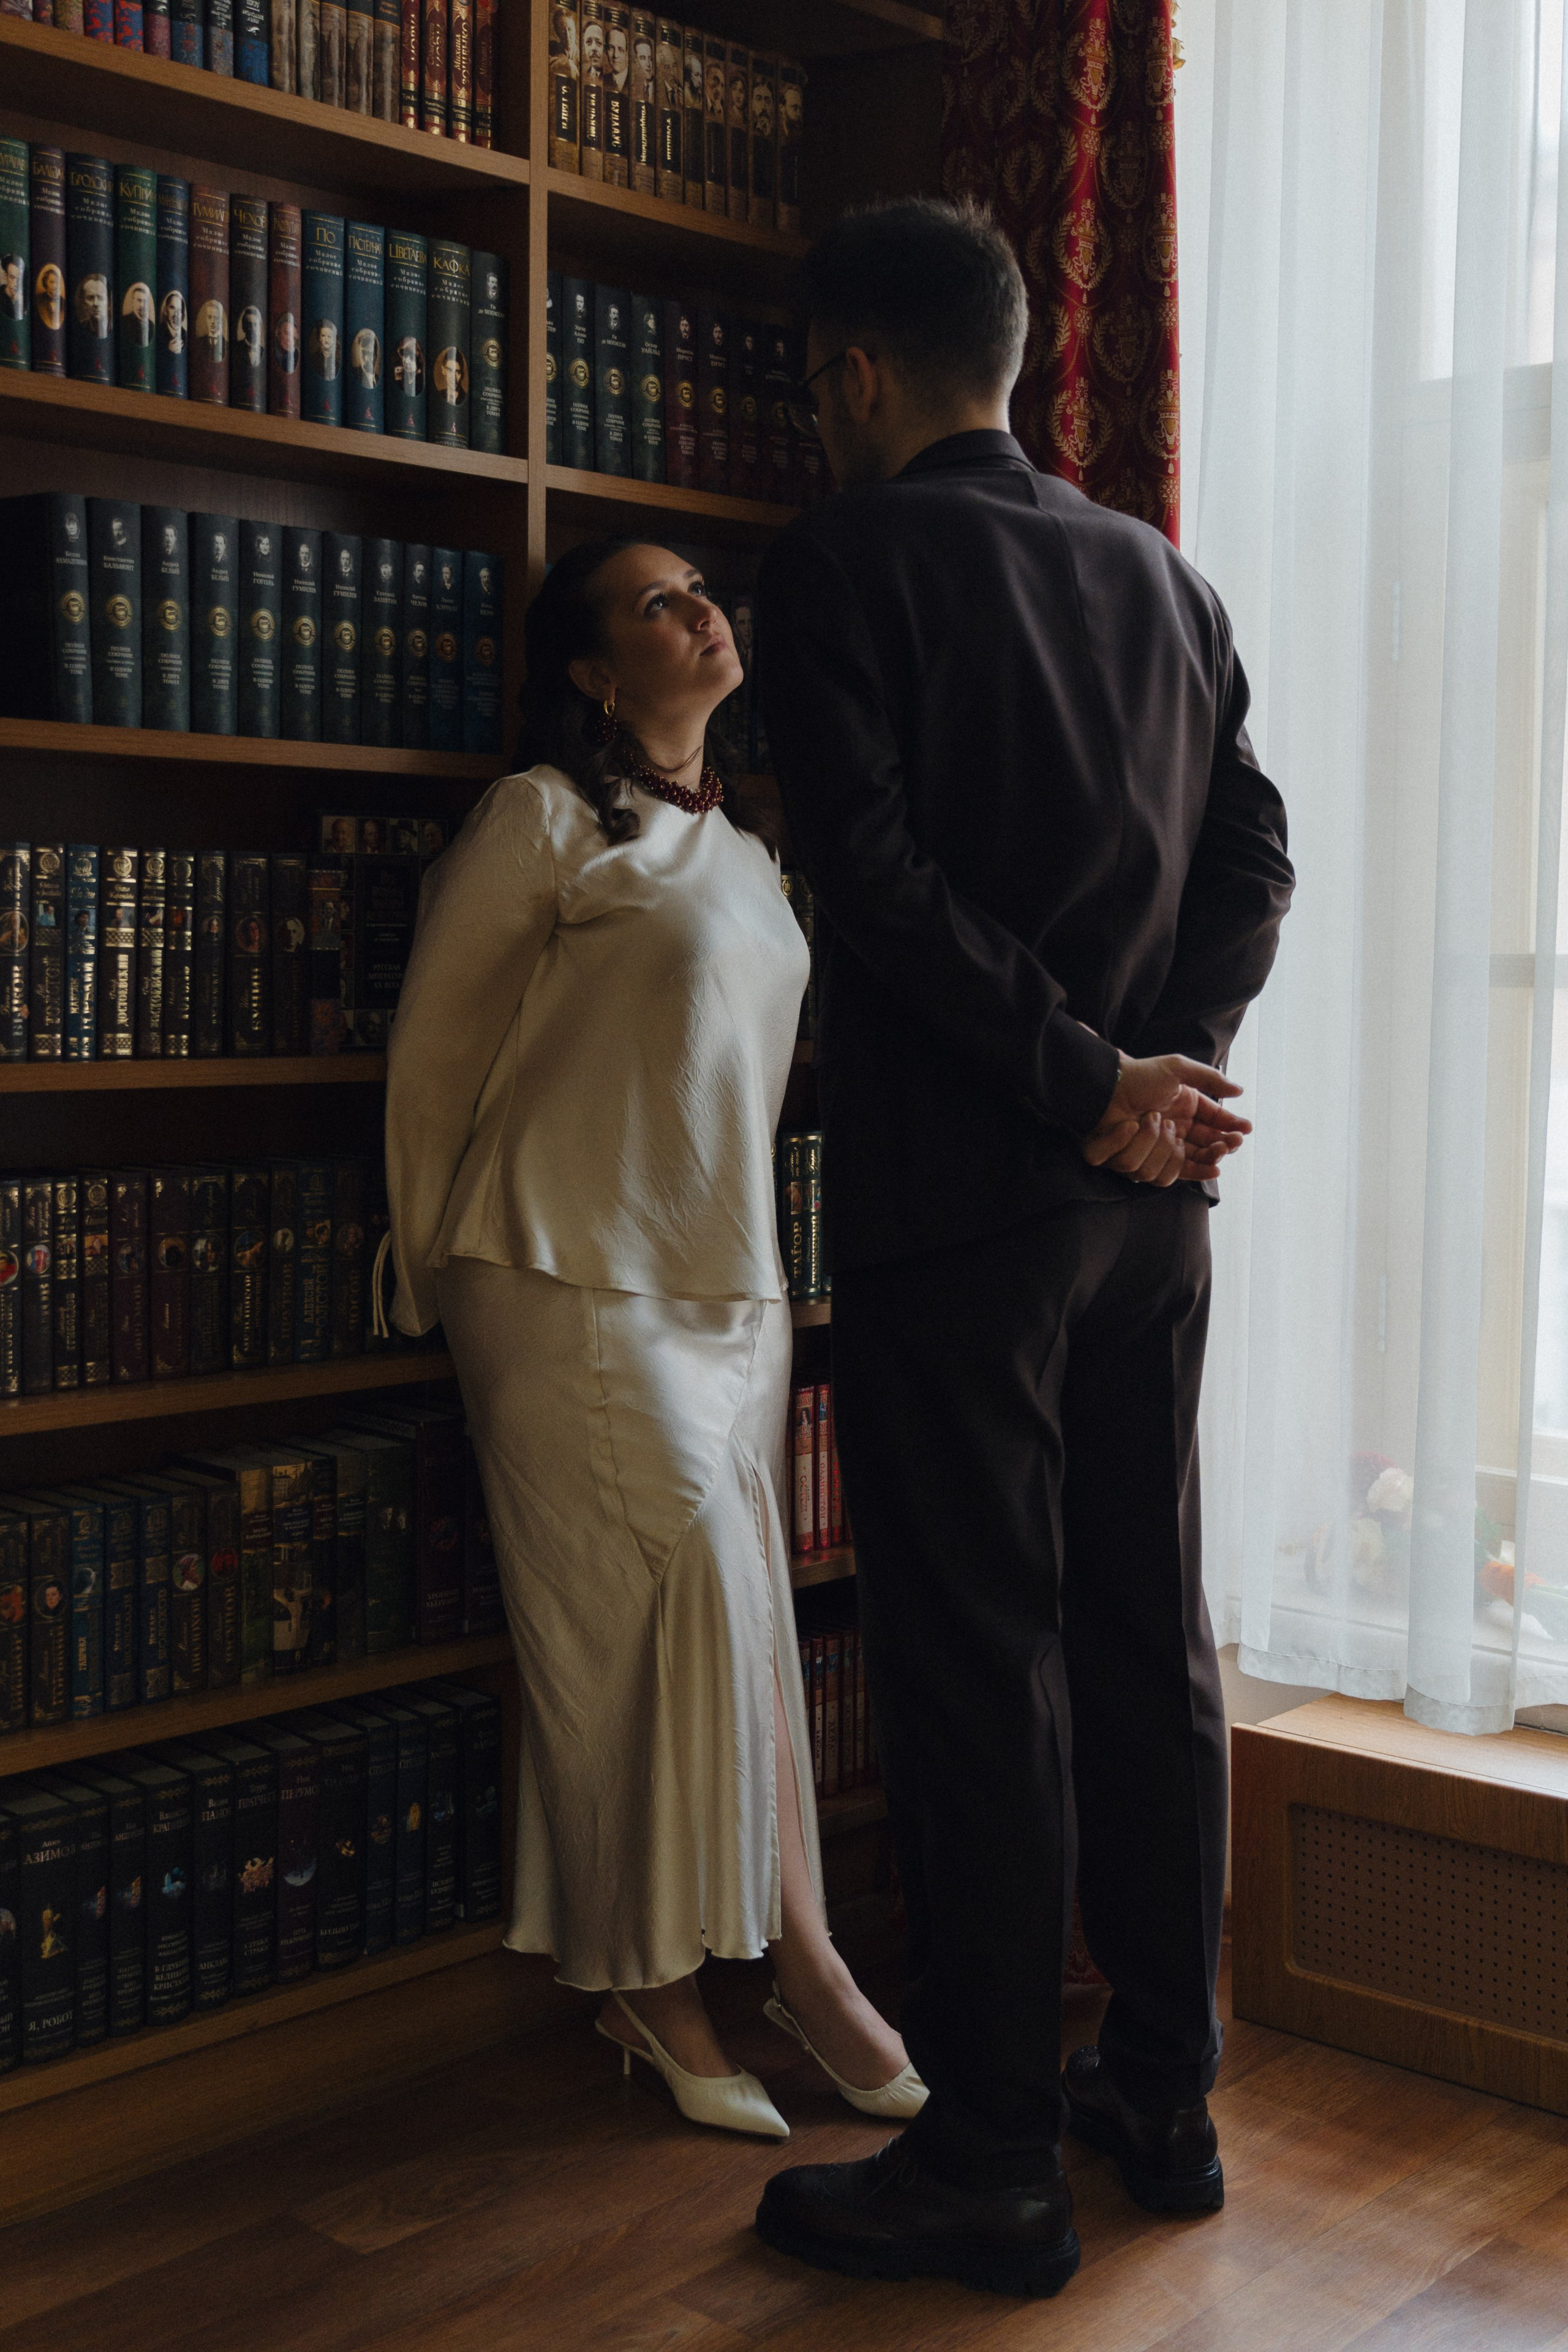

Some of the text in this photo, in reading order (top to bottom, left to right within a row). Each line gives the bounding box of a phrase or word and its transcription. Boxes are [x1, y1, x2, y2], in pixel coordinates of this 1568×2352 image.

[461, 21, 470, 85] ЗОЩЕНКО
[611, 100, 622, 148] ВУДХАУС
[234, 208, 267, 228] ЧЕХОВ
[316, 227, 336, 244] ПО
[349, 236, 383, 255] ПАСТЕРНАК
[314, 249, 336, 259] Малое
[356, 259, 378, 270] Малое
[389, 243, 428, 265] ЦВЕТАЕВА
[433, 256, 470, 276] КАФКА
[441, 279, 464, 289] Малое
[677, 354, 693, 363] ПРУСТ
[103, 562, 134, 571] БАЛЬМОНТ
[161, 566, 180, 575] БЕЛЫЙ
[211, 574, 230, 582] БЕЛЫЙ
[410, 599, 428, 608] ЧЕХОВ
[42, 954, 61, 1027] ТОЛСТОЙ
[69, 978, 79, 1015] МАКСИМ
[77, 961, 95, 1031] ГОРЬКИЙ
[117, 953, 129, 1027] ДОСТОЕВСКИЙ
[149, 949, 163, 1028] ДОСТОЕВСКИЙ
[251, 967, 263, 1031] БУНИН
[11, 964, 25, 1037] БЫКОВ
[281, 1262, 293, 1340] ПРУТКОВ
[303, 1278, 314, 1324] АЛЕКСЕЙ
[312, 1262, 329, 1338] ТОЛСТОЙ
[66, 1292, 77, 1351] ГРИБОЕДОВ
[123, 1593, 132, 1666] ШОЛОХОВ
[157, 1587, 168, 1660] ШОЛОХОВ
[190, 1596, 202, 1673] ШОЛОХОВ
[10, 1632, 24, 1711] ВИЗБОР
[49, 1624, 64, 1708] ГОРЬКИЙ
[250, 1783, 267, 1793] Терри
[296, 1776, 311, 1785] Ник
[208, 1798, 229, 1807] Вадим
[22, 1843, 77, 1866] АЗИМОВ
[320, 1926, 349, 1936] КОЛЬЦО
[28, 2010, 74, 2032] Я, РОБОТ
